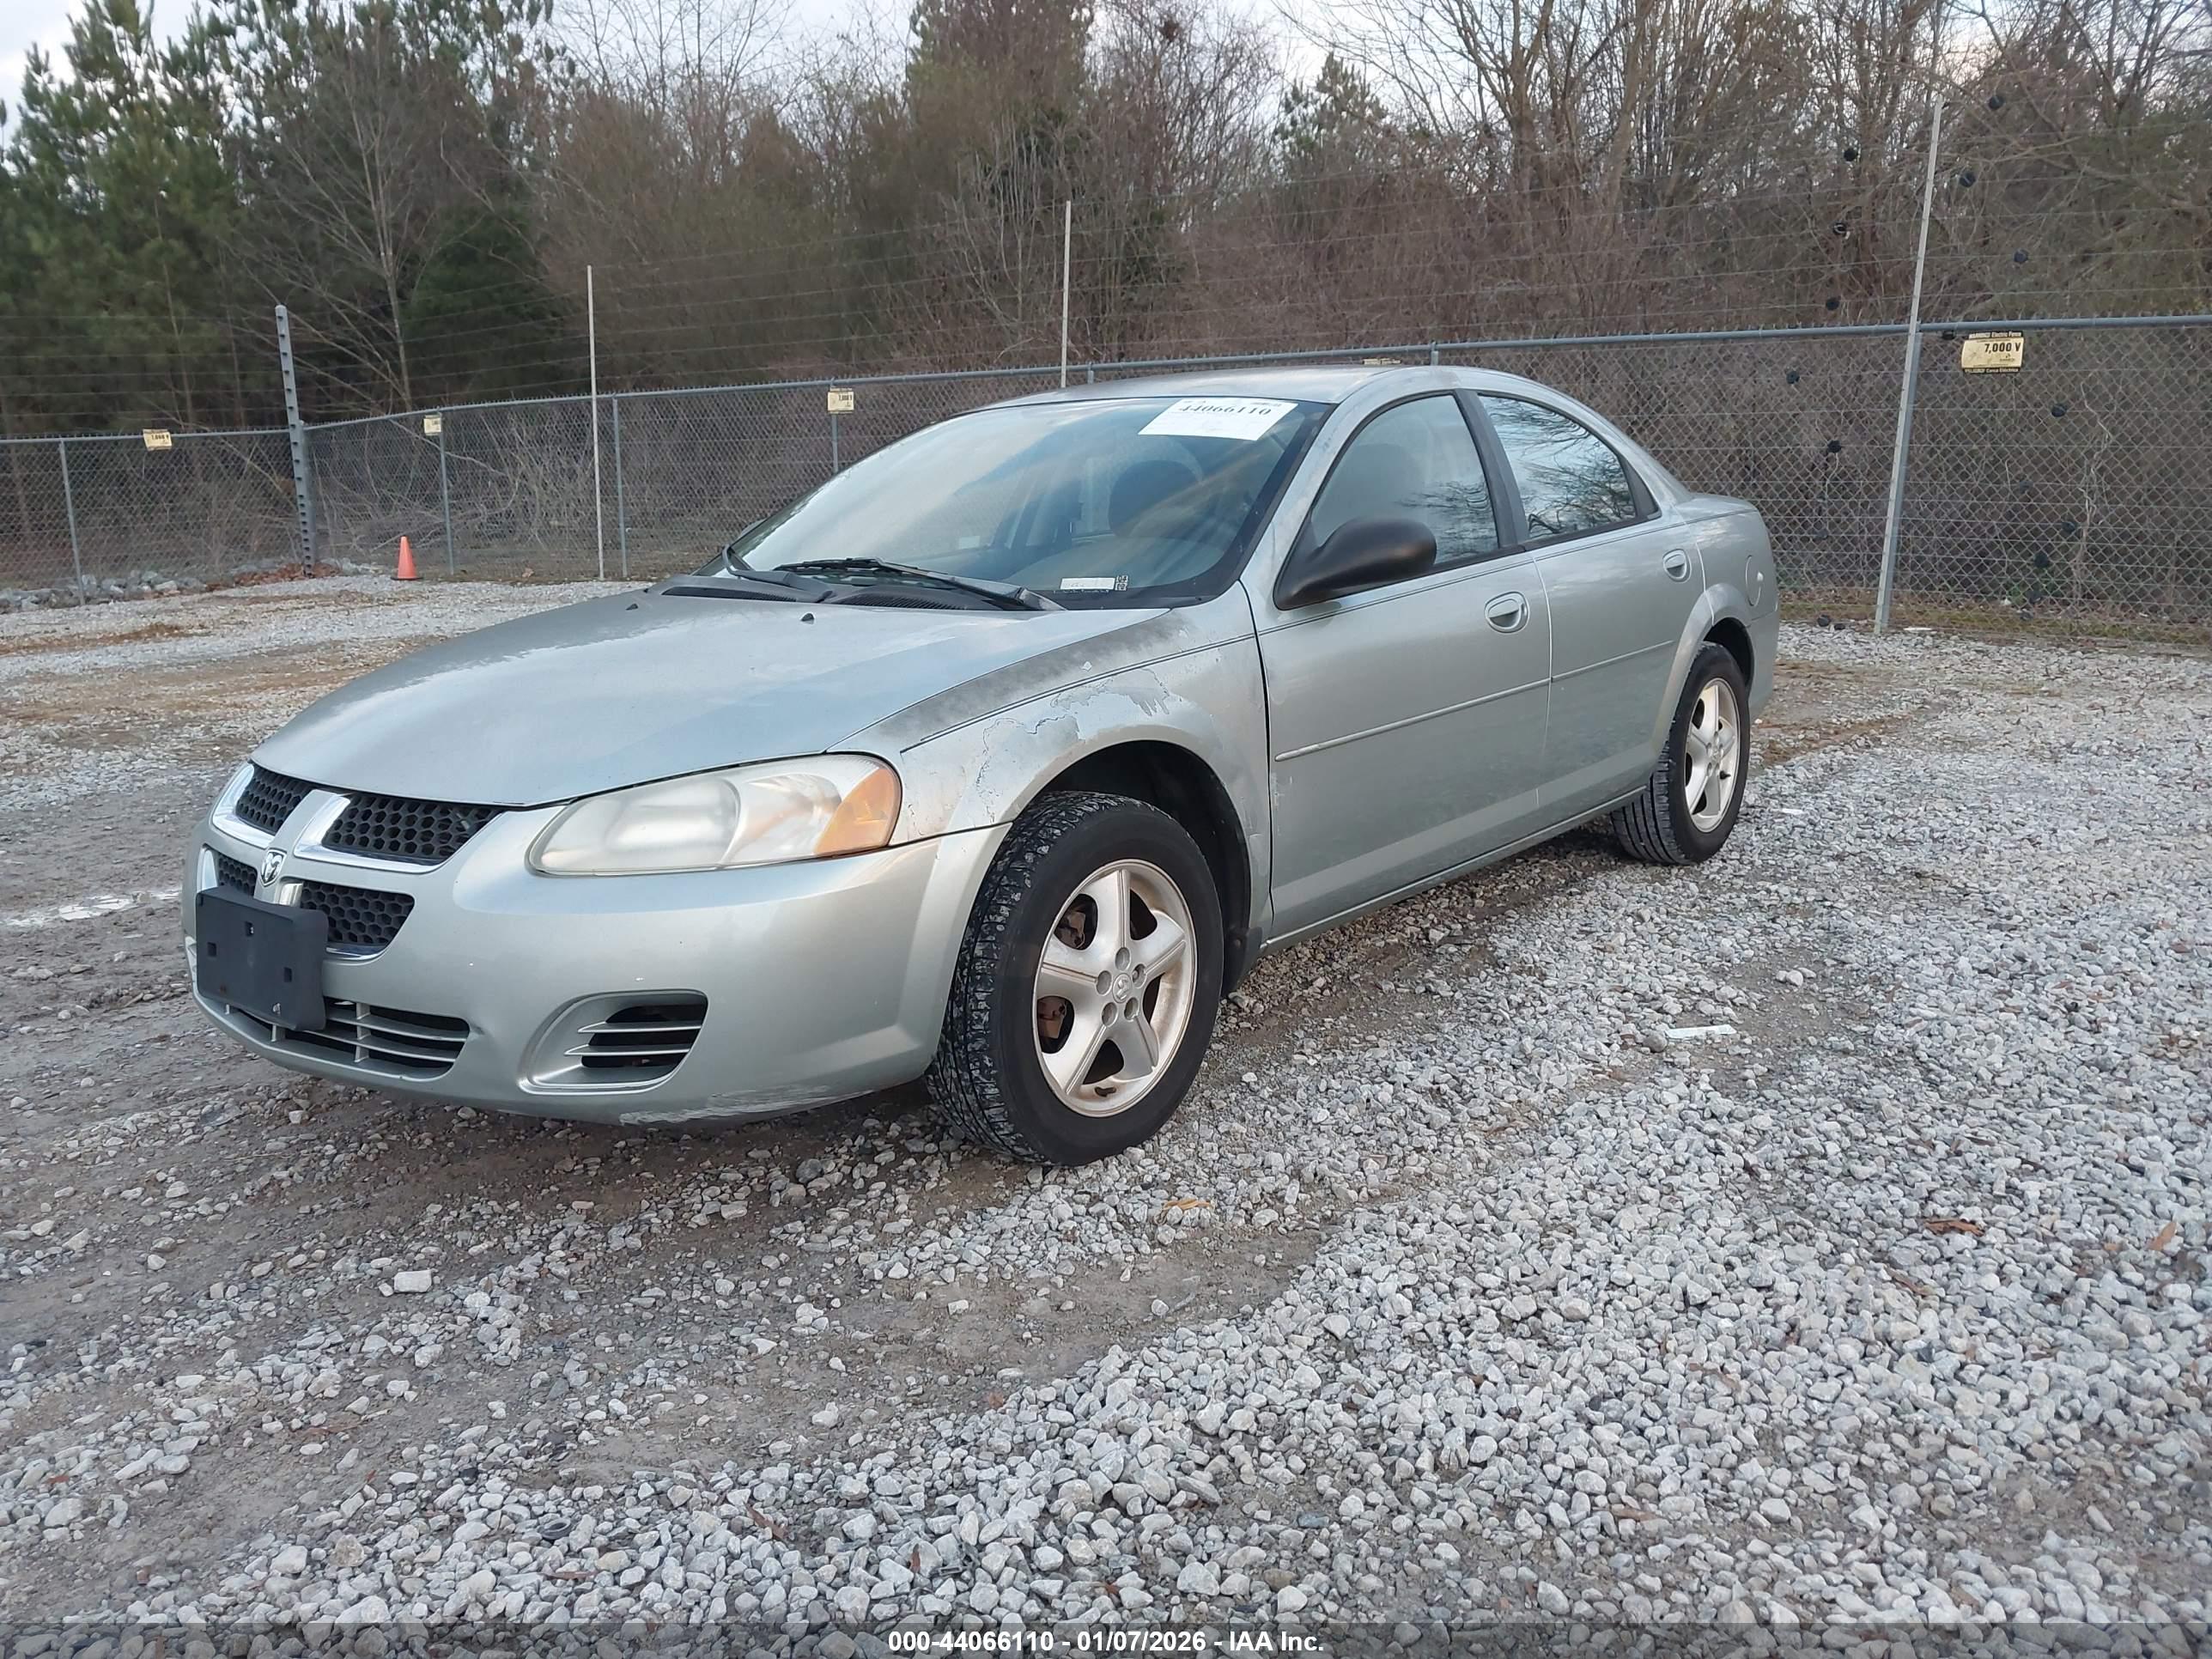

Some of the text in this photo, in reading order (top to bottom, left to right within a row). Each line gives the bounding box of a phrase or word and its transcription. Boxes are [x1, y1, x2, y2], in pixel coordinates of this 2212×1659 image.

[1984, 343, 2021, 354] 7,000 V
[1179, 404, 1272, 415] 44066110
